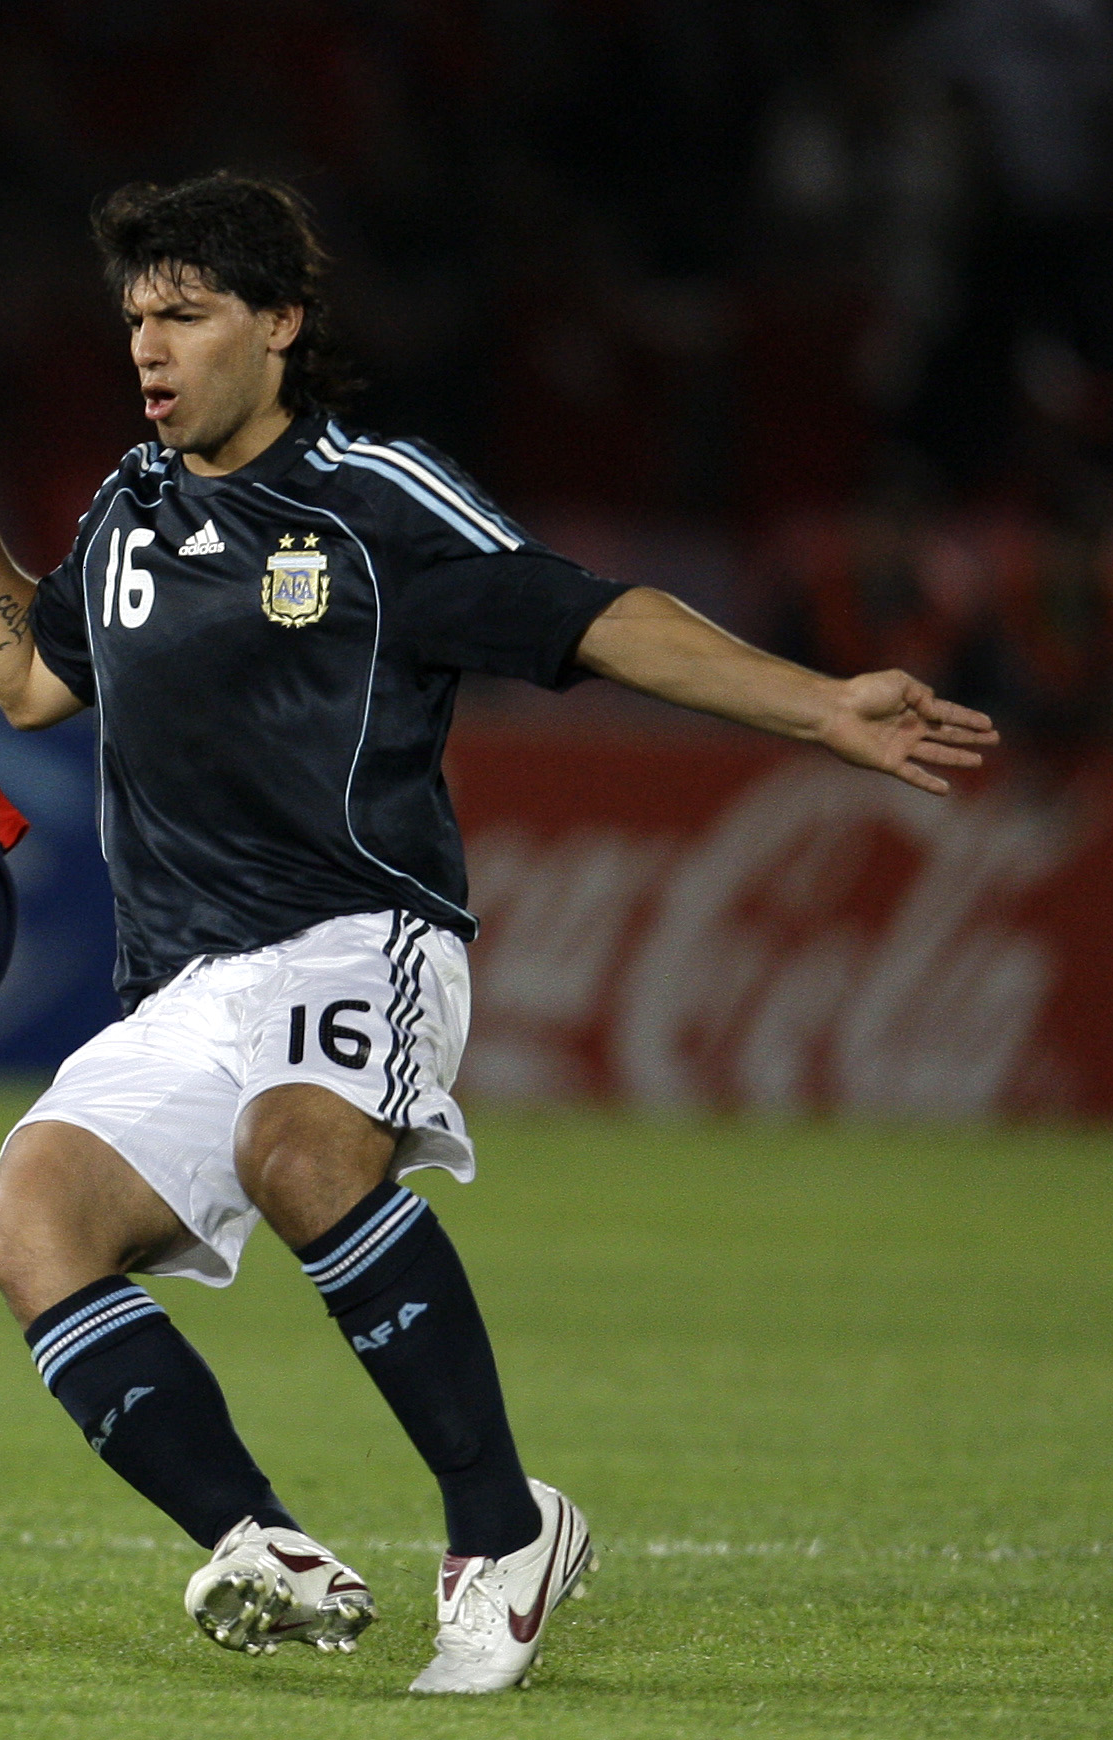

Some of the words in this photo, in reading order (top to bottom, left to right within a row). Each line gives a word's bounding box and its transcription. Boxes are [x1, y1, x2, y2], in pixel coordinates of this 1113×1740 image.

[102, 526, 157, 630] 16
[177, 540, 226, 557] adidas
[288, 999, 373, 1070] 16
[351, 1301, 428, 1353] AFA
